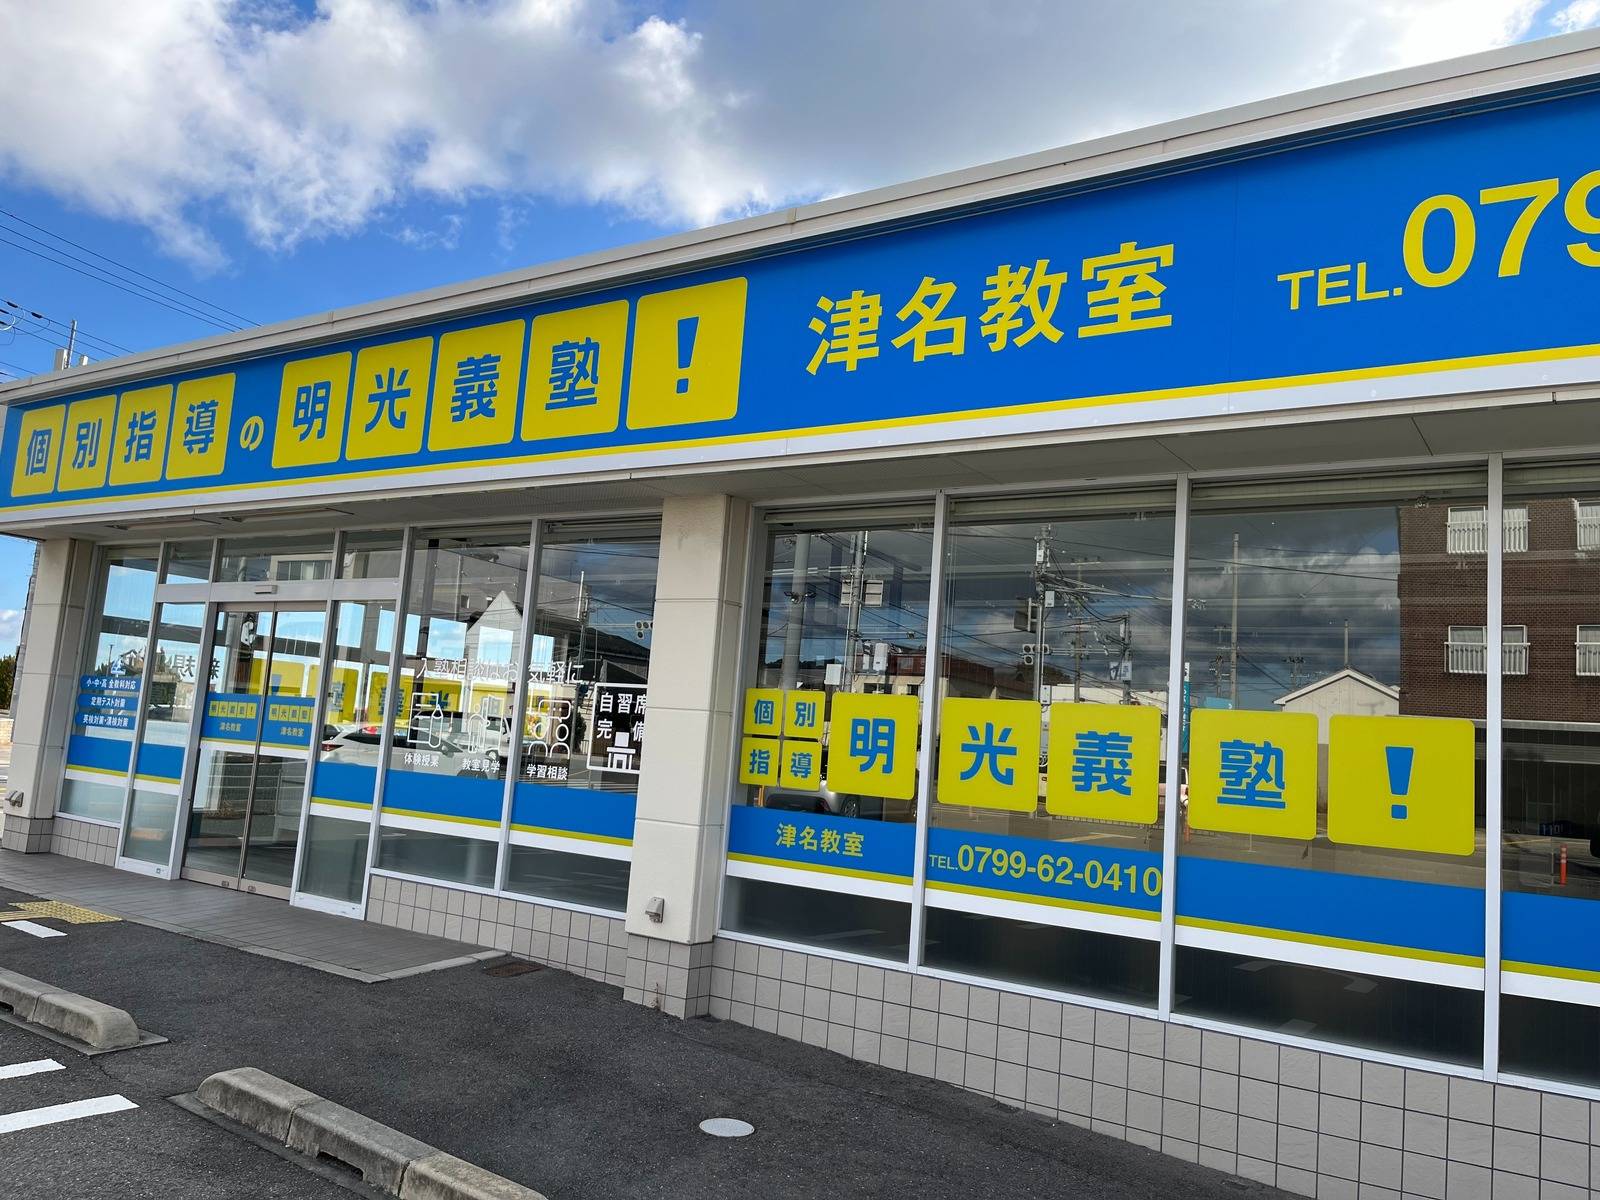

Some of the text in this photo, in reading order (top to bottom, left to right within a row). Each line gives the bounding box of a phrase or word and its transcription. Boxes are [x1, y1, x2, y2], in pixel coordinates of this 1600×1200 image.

[806, 241, 1175, 376] 津名教室
[599, 692, 648, 715] 自習席
[754, 698, 815, 728] 個別
[462, 758, 501, 774] 教室見学
[526, 763, 568, 781] 学習相談
[749, 748, 813, 780] 指導
[849, 717, 1415, 820] 明光義塾!
[775, 822, 864, 858] 津名教室
